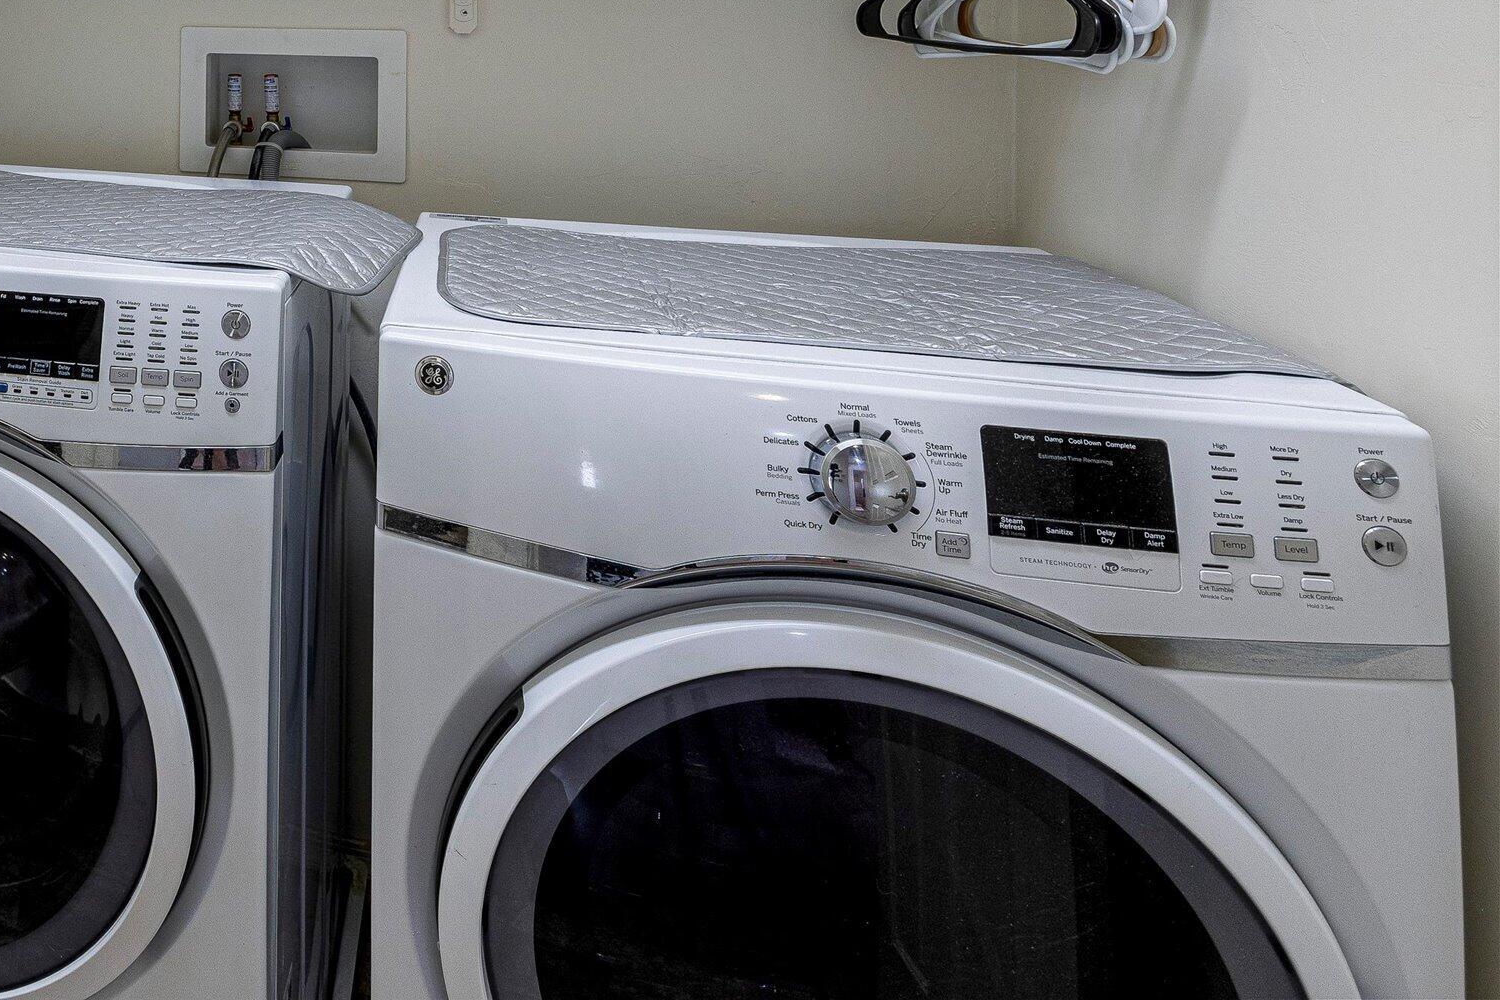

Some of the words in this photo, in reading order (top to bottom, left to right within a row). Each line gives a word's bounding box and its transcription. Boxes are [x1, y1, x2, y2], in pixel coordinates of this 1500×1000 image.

[840, 403, 870, 411] Normal
[838, 410, 856, 418] Mixed
[787, 415, 818, 423] Cottons
[894, 419, 921, 428] Towels
[763, 437, 800, 446] Delicates
[1014, 433, 1035, 442] Drying
[1044, 435, 1064, 444] Damp
[1105, 441, 1136, 450] Complete
[925, 442, 953, 451] Steam
[926, 450, 968, 460] Dewrinkle
[1358, 448, 1384, 456] Power
[767, 464, 789, 474] Bulky
[767, 472, 793, 481] Bedding
[1280, 470, 1292, 478] Dry
[938, 479, 963, 487] Warm
[755, 489, 775, 498] Perm
[776, 491, 800, 499] Press
[938, 486, 951, 494] Up
[775, 498, 801, 506] Casuals
[935, 509, 948, 517] Air
[950, 510, 968, 518] Fluff
[1283, 517, 1303, 525] Damp
[1356, 514, 1378, 522] Start
[1387, 516, 1412, 525] Pause
[784, 520, 806, 529] Quick
[808, 522, 823, 531] Dry
[1000, 523, 1026, 531] Refresh
[1046, 527, 1073, 536] Sanitize
[1097, 529, 1116, 537] Delay
[911, 532, 932, 541] Time
[1101, 537, 1114, 545] Dry
[1144, 532, 1166, 541] Damp
[911, 540, 926, 549] Dry
[942, 538, 958, 546] Add
[1147, 540, 1165, 548] Alert
[1222, 540, 1247, 550] Temp
[943, 545, 962, 554] Time
[1285, 545, 1309, 554] Level
[1045, 559, 1092, 569] TECHNOLOGY
